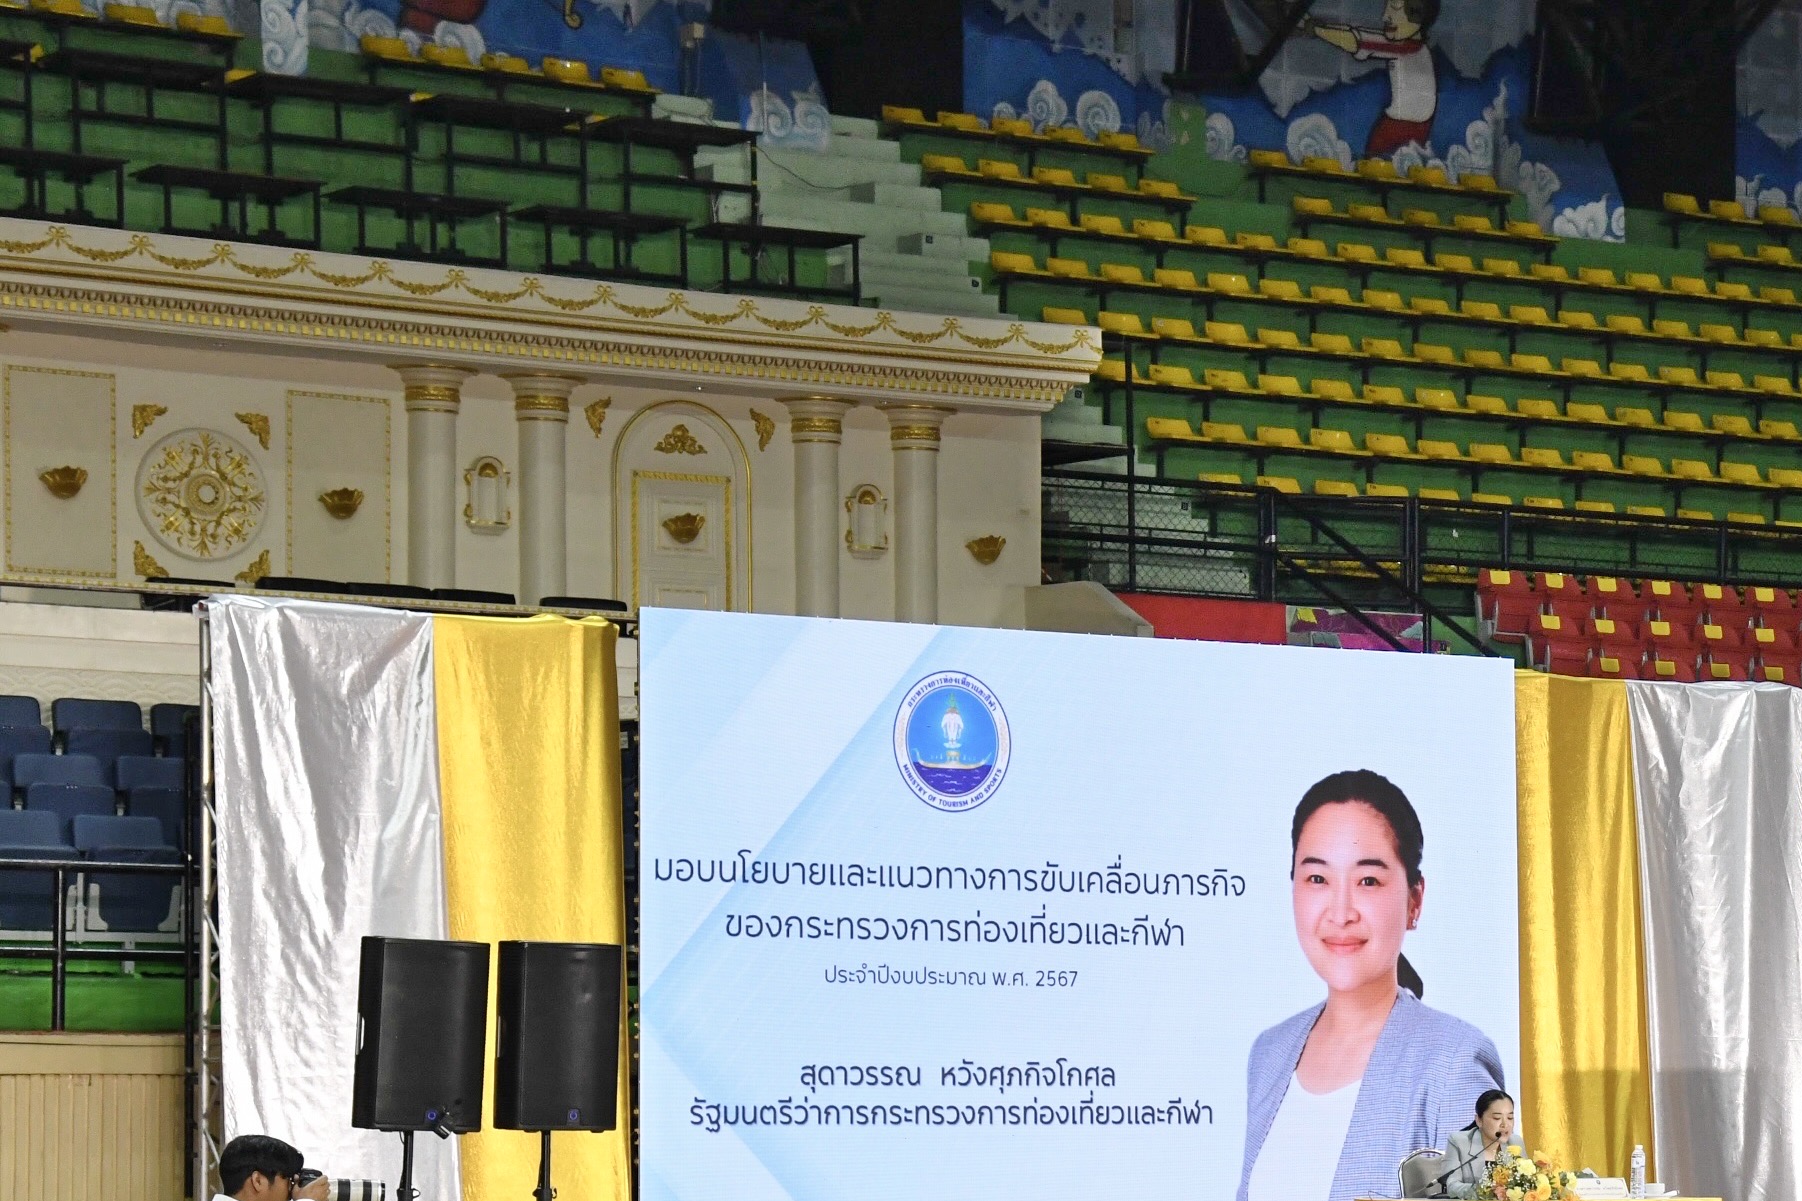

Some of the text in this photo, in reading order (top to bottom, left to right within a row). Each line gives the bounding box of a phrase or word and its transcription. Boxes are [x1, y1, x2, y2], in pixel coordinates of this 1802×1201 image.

[903, 764, 1003, 808] MINISTRY OF TOURISM AND SPORTS
[654, 849, 1246, 897] มอบนโยบายและแนวทางการขับเคลื่อนภารกิจ
[725, 904, 1184, 947] ของกระทรวงการท่องเที่ยวและกีฬา
[824, 962, 1078, 987] ประจำปีงบประมาณ พ.ศ. 2567
[800, 1057, 1116, 1095] สุดาวรรณ หวังศุภกิจโกศล
[690, 1090, 1213, 1133] รัฐมนตรีว่าการกระทรวงการท่องเที่ยวและกีฬา
